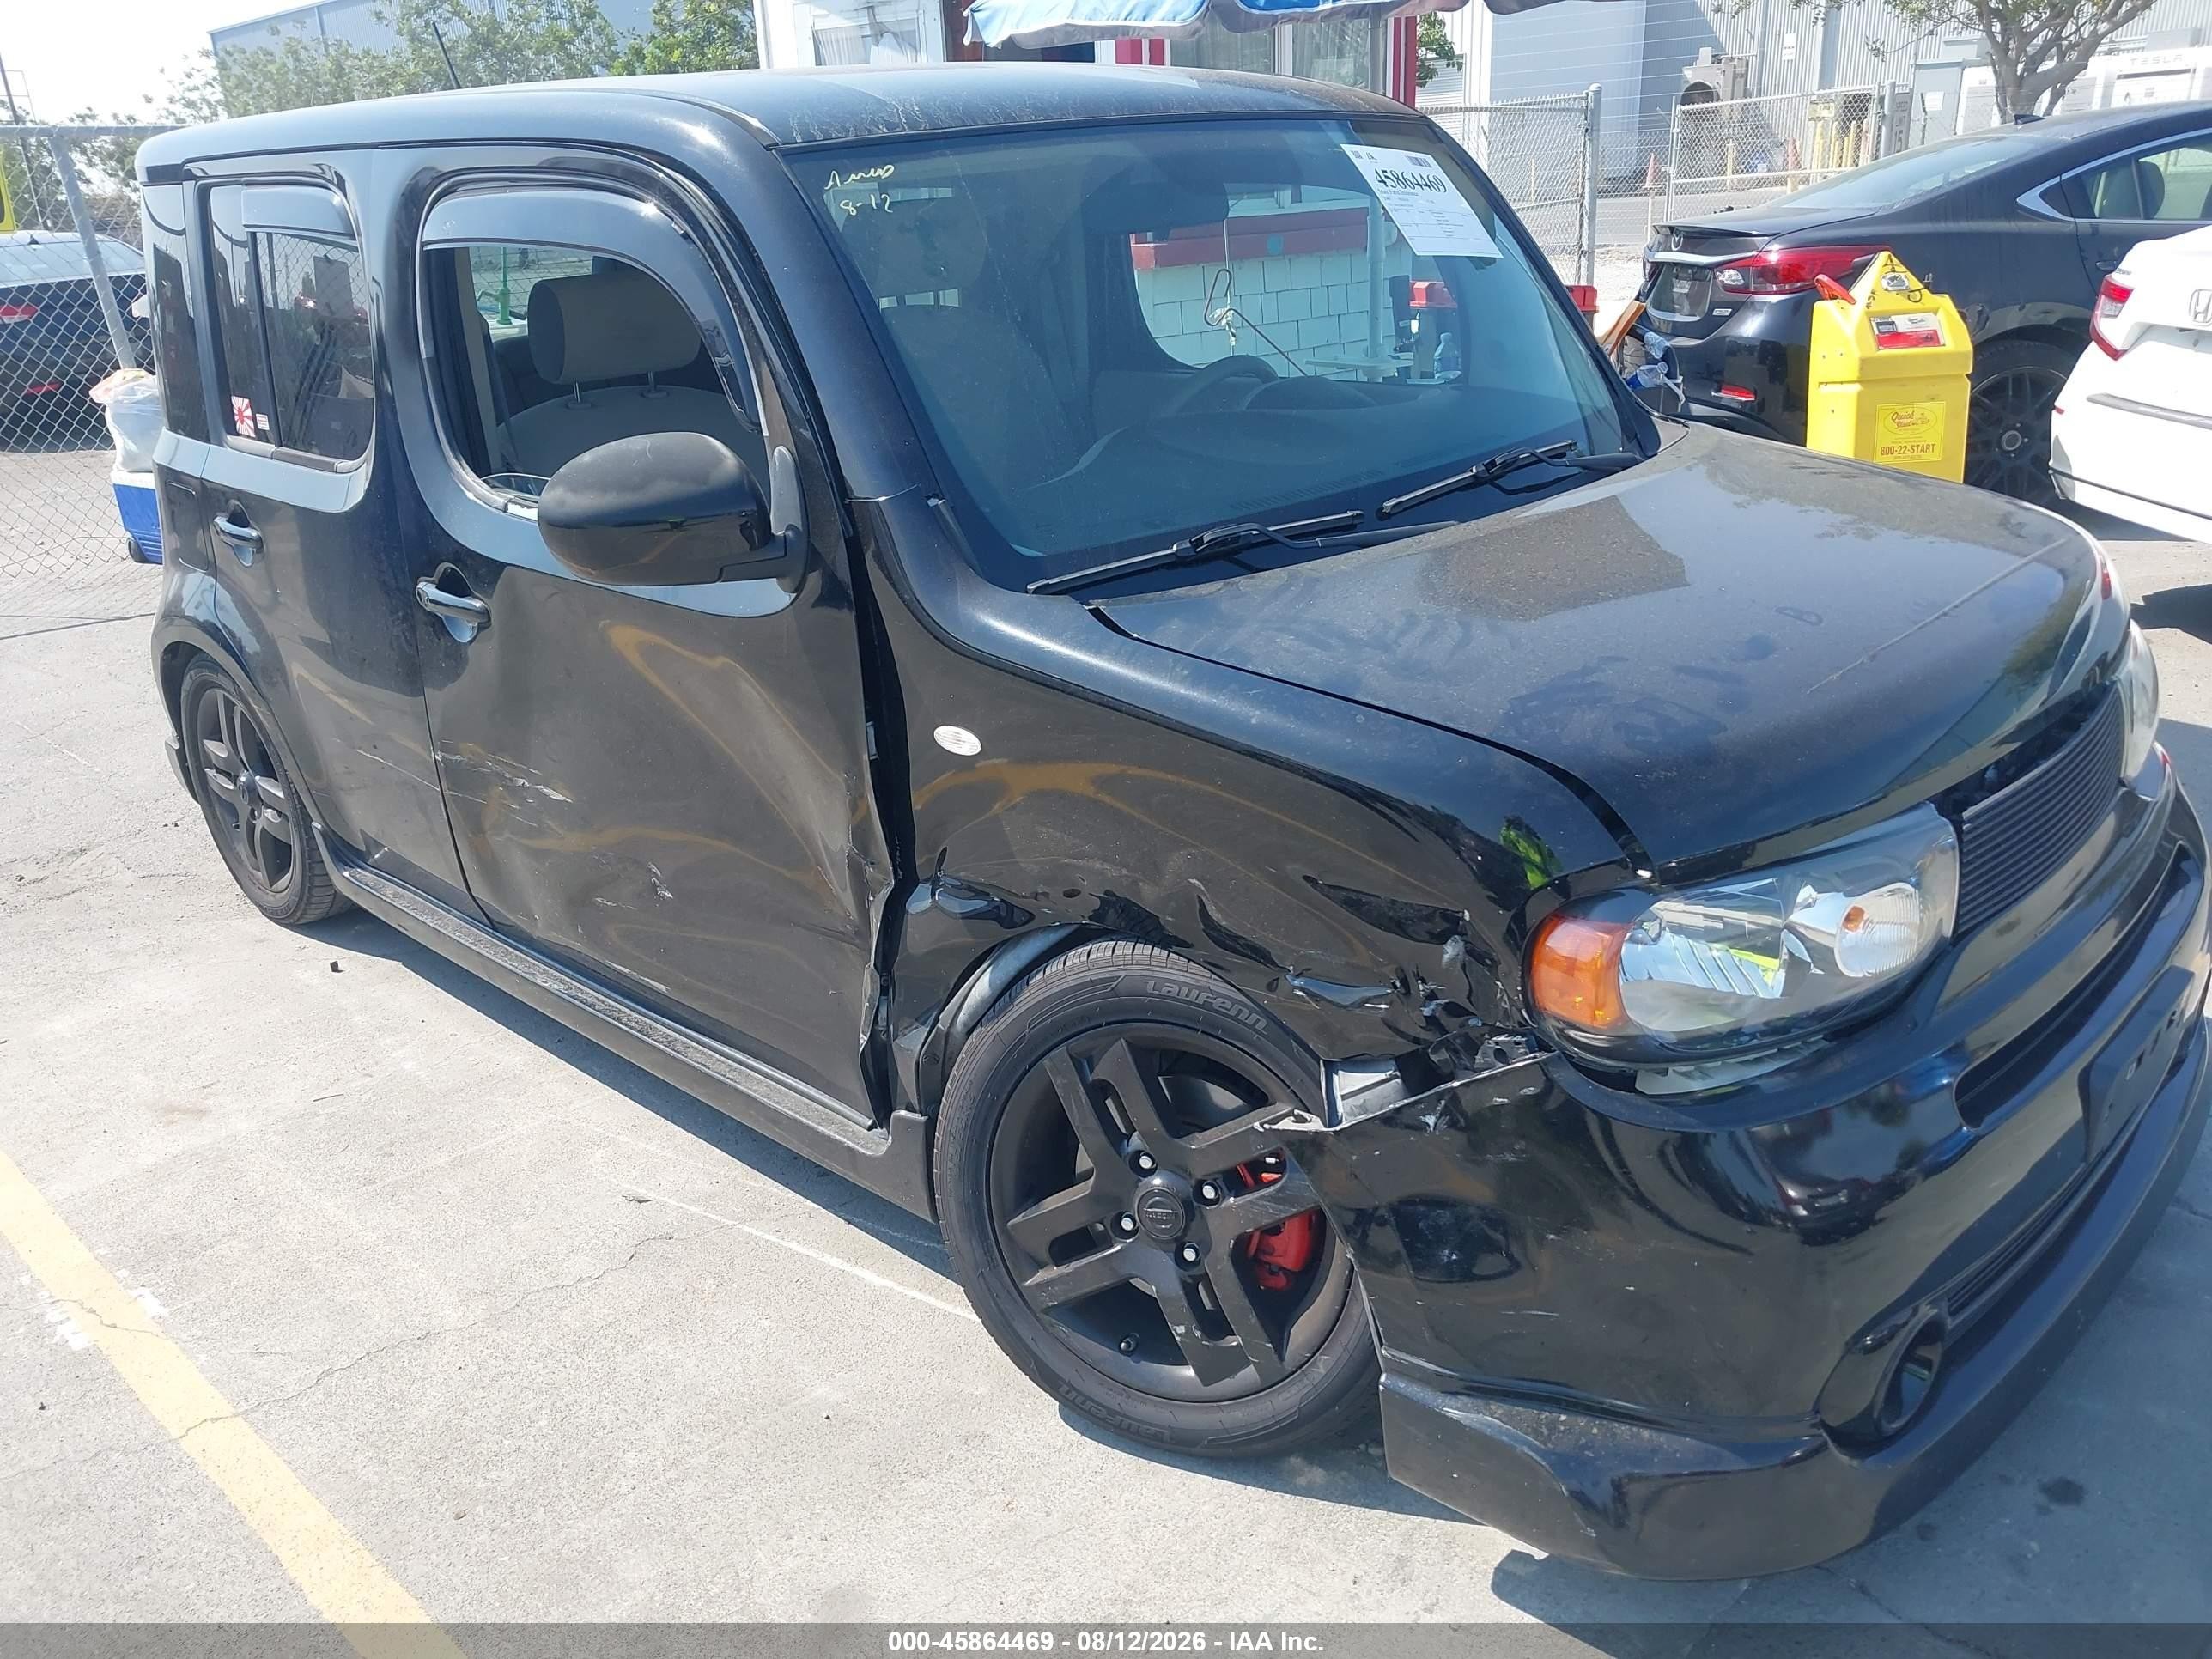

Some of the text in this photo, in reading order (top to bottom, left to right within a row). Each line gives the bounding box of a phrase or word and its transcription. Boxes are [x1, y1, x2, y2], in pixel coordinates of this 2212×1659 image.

[2130, 53, 2182, 65] TESLA
[1374, 168, 1448, 193] 45864469
[840, 193, 893, 216] 8-12
[1880, 443, 1936, 456] 800-22-START
[1142, 980, 1268, 1036] Laufenn
